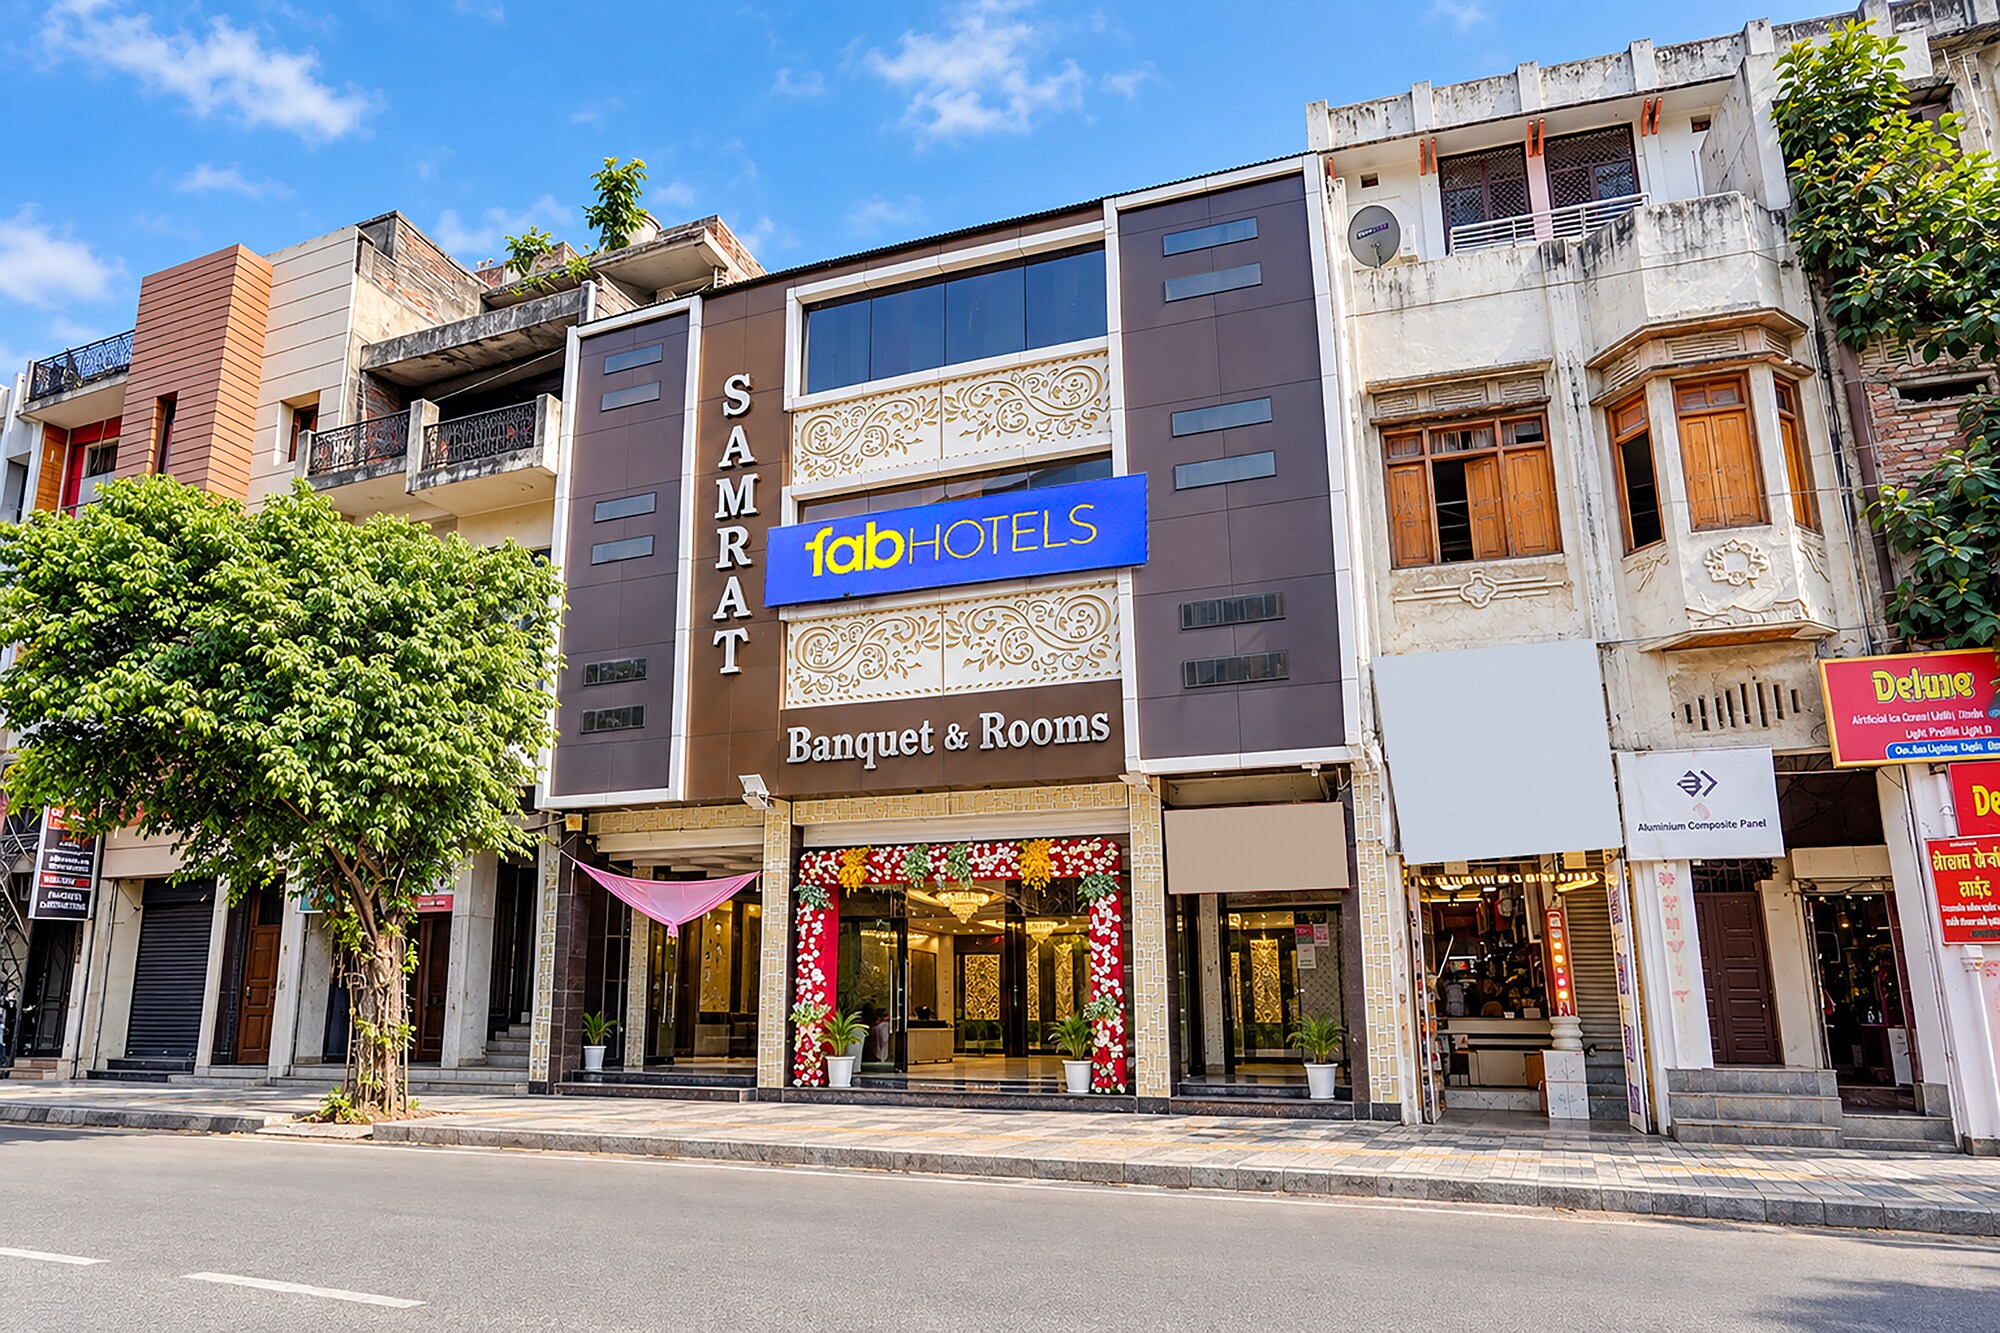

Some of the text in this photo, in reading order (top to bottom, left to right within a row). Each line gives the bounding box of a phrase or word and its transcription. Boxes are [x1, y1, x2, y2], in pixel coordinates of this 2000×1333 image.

[713, 372, 761, 675] SAMRAT
[786, 711, 1111, 770] Banquet & Rooms
[1638, 818, 1767, 832] Aluminium Composite Panel
